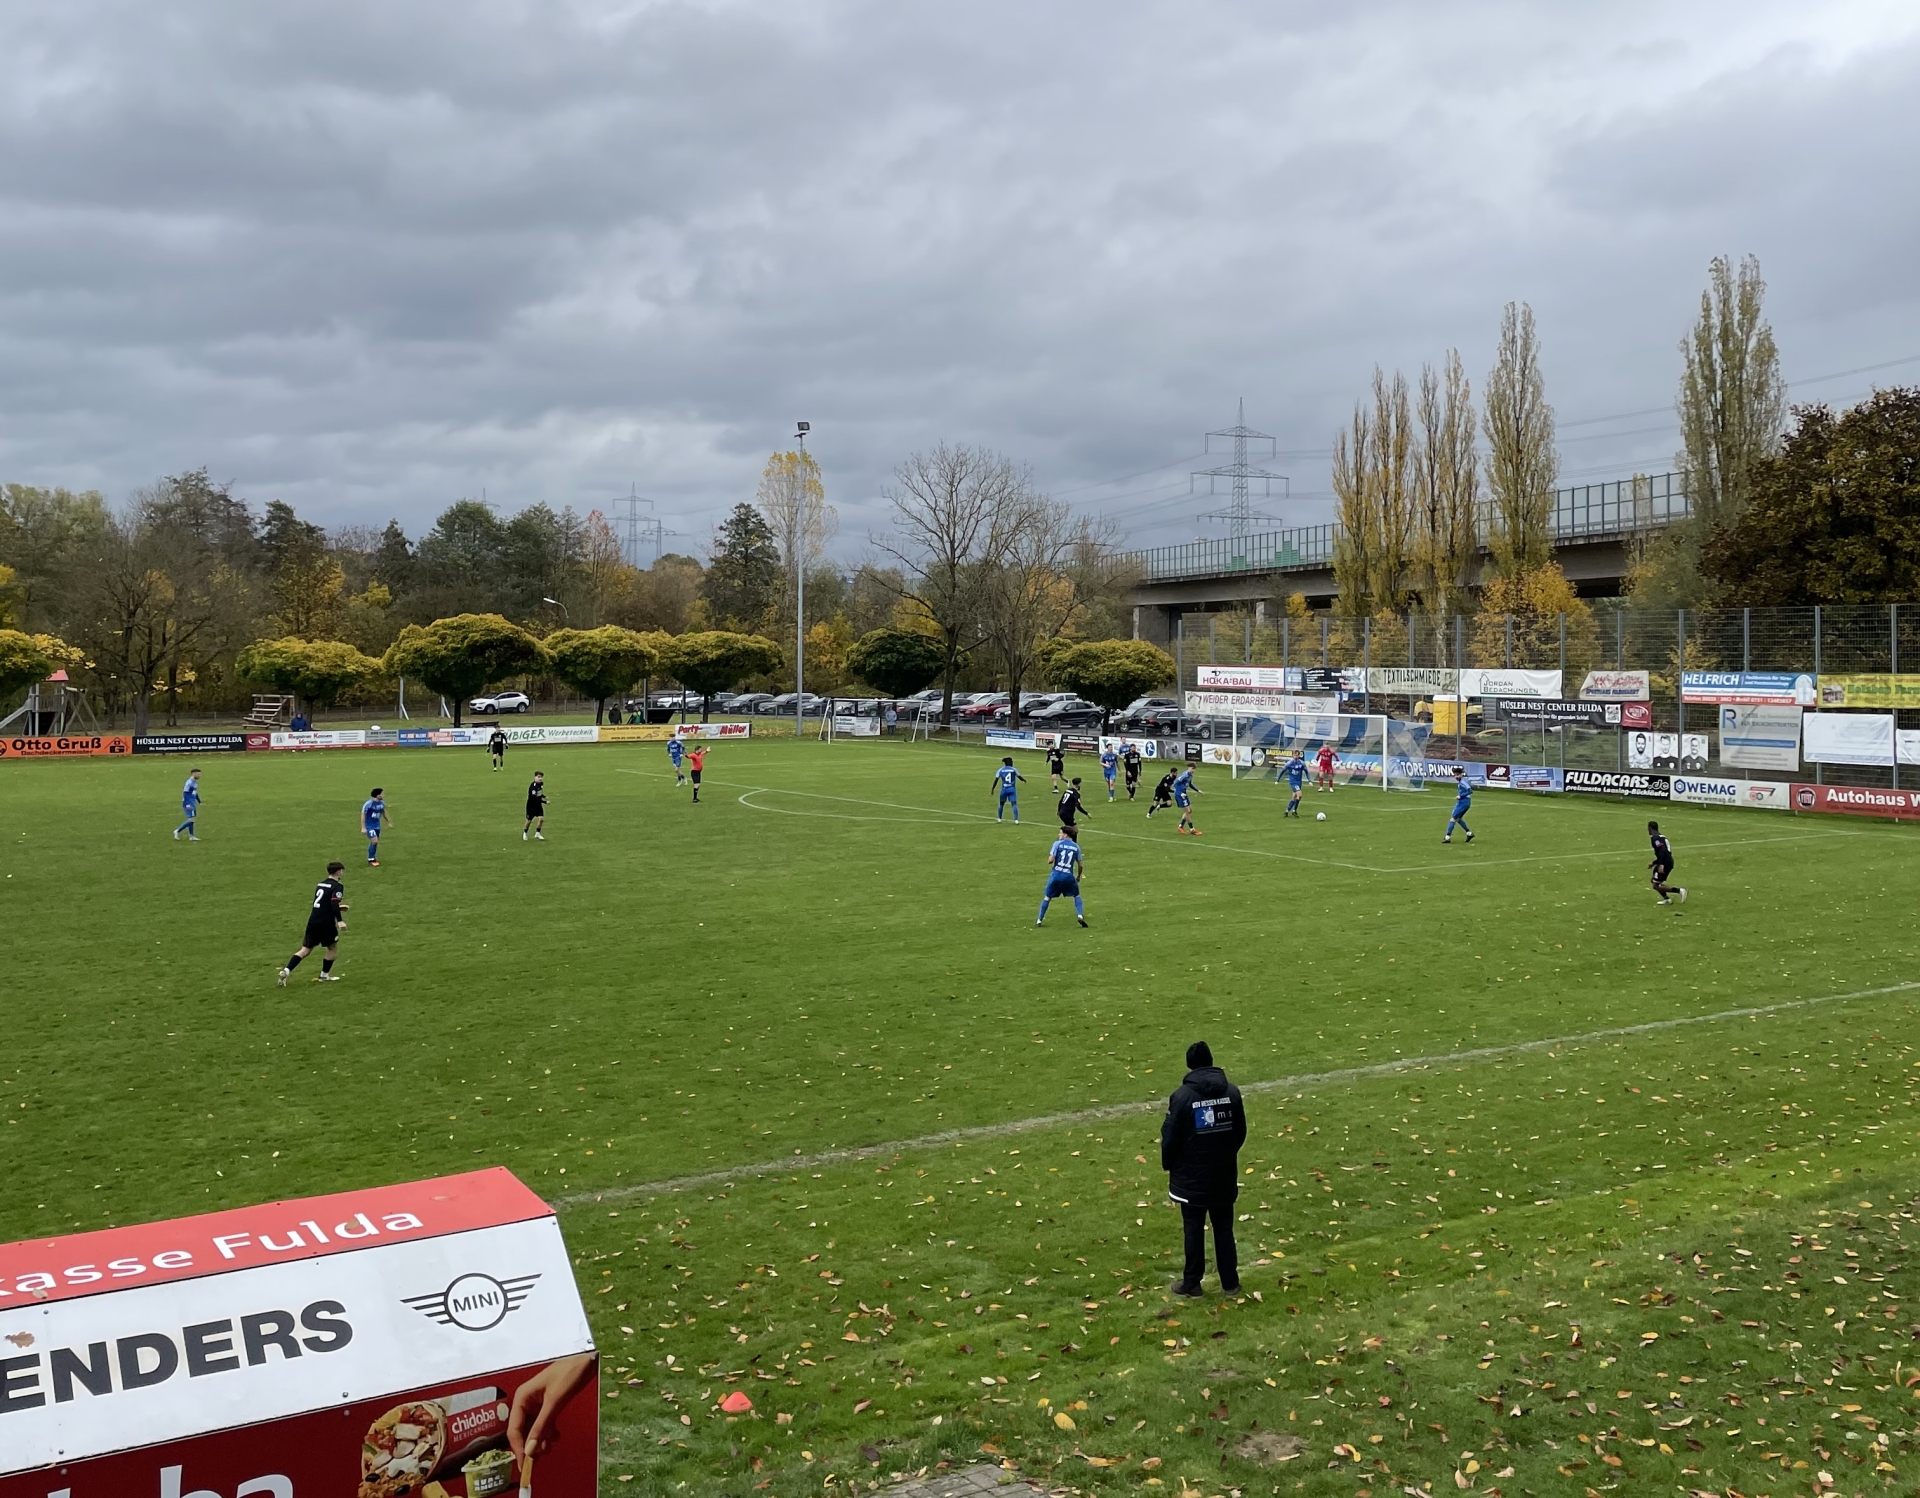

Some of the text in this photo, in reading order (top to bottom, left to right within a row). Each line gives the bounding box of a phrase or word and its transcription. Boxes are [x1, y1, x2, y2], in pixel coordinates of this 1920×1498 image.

[1383, 669, 1441, 686] TEXTILSCHMIEDE
[1684, 674, 1740, 685] HELFRICH
[1202, 694, 1282, 706] WEIDER ERDARBEITEN
[1500, 700, 1602, 713] HÜSLER NEST CENTER FULDA
[1722, 708, 1737, 730] R
[548, 729, 593, 737] Werbetechnik
[719, 724, 747, 735] Müller
[12, 736, 101, 751] Otto Gruß
[136, 737, 165, 745] HÜSLER
[167, 737, 186, 745] NEST
[187, 736, 217, 744] CENTER
[1004, 772, 1012, 784] 4
[1565, 771, 1669, 791] FULDACARS.de
[1565, 785, 1669, 797] preiswerte Leasing-Rückläufer
[1687, 781, 1736, 796] WEMAG
[1687, 795, 1736, 804] www.wemag.de
[1826, 788, 1906, 807] Autohaus
[1058, 849, 1074, 868] 11
[313, 889, 325, 908] 2
[211, 1212, 424, 1260] Fulda
[452, 1289, 501, 1314] MINI
[0, 1299, 353, 1414] ENDERS
[451, 1408, 496, 1435] chidoba
